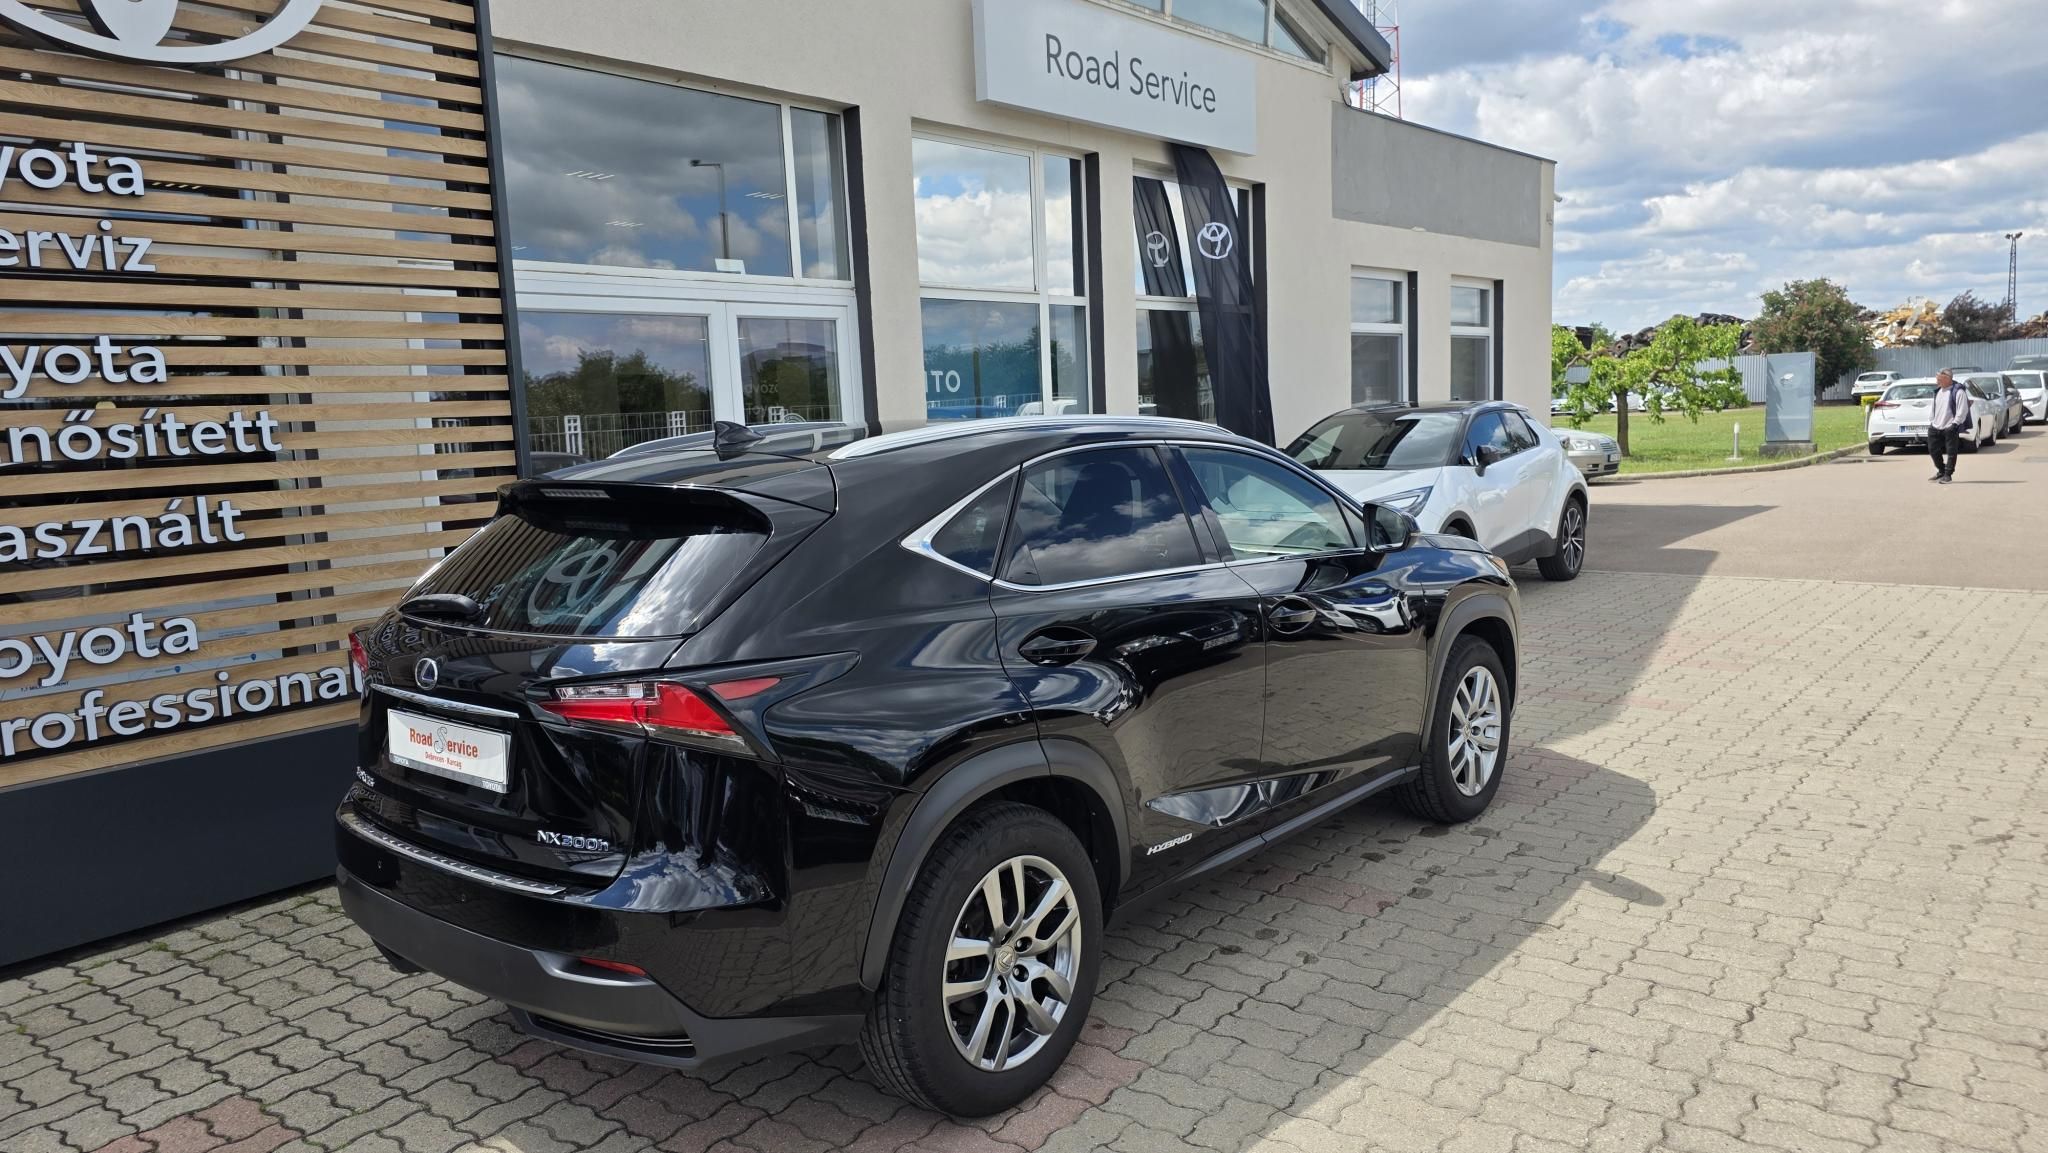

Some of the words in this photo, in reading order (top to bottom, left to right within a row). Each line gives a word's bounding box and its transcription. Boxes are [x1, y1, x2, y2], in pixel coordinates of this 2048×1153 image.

[1045, 33, 1120, 91] Road
[1129, 57, 1216, 113] Service
[0, 335, 168, 399] yota
[926, 369, 961, 393] TO
[8, 408, 283, 464] nősített
[0, 496, 246, 564] asznált
[0, 611, 199, 687] oyota
[409, 727, 433, 747] Road
[537, 829, 609, 852] NX300h
[1146, 832, 1193, 856] HYBRID
